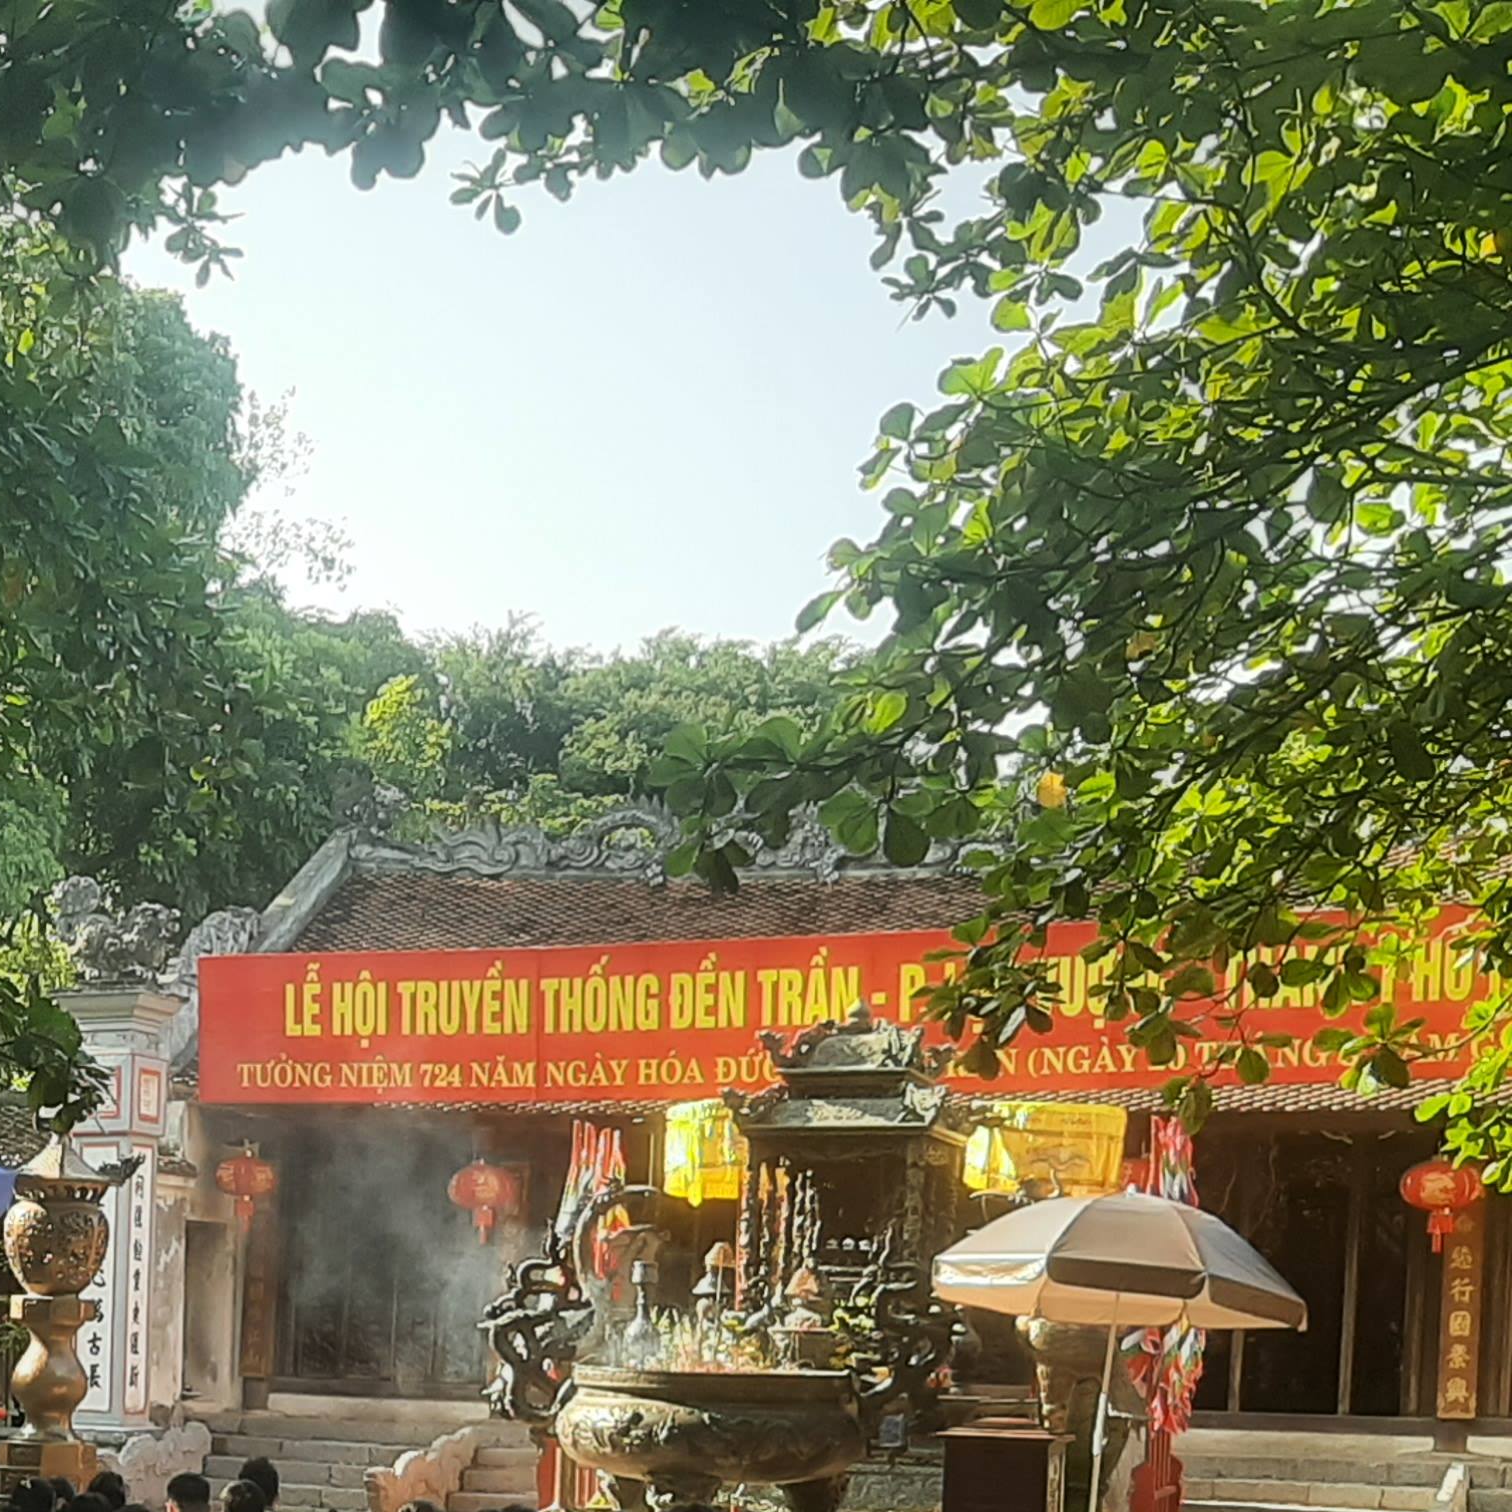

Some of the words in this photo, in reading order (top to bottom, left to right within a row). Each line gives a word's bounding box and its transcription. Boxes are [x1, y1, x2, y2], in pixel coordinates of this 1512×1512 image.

[284, 962, 322, 1037] LỄ
[331, 970, 388, 1048] HỘI
[396, 960, 529, 1036] TRUYỀN
[540, 955, 661, 1034] THỐNG
[669, 952, 746, 1031] ĐỀN
[756, 946, 861, 1027] TRẦN
[237, 1052, 332, 1088] TƯỞNG
[339, 1055, 412, 1094] NIỆM
[419, 1063, 463, 1088] 724
[470, 1055, 536, 1088] NĂM
[544, 1052, 629, 1089] NGÀY
[637, 1050, 705, 1085] HÓA
